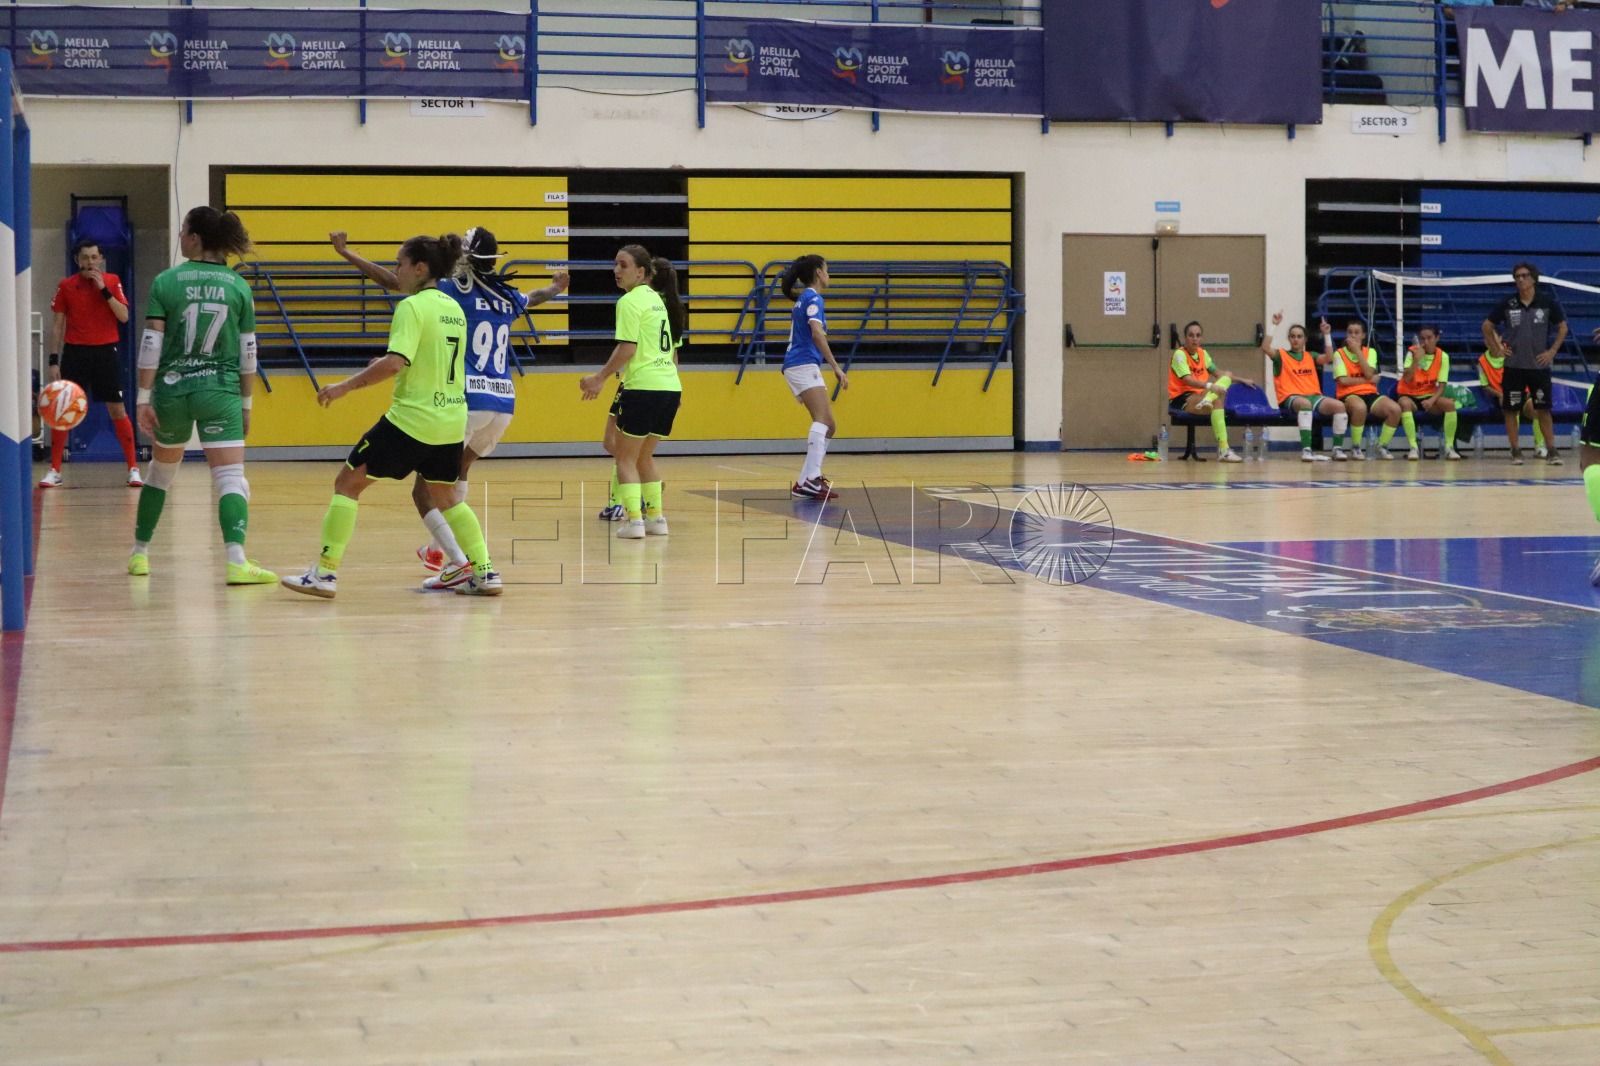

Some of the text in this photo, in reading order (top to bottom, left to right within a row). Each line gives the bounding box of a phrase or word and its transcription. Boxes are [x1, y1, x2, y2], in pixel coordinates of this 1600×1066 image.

[64, 38, 109, 48] MELILLA
[183, 40, 228, 49] MELILLA
[301, 40, 346, 50] MELILLA
[417, 40, 461, 50] MELILLA
[64, 49, 101, 58] SPORT
[183, 50, 220, 60] SPORT
[301, 51, 336, 60] SPORT
[417, 51, 452, 60] SPORT
[759, 46, 800, 58] MELILLA
[64, 58, 109, 69] CAPITAL
[183, 60, 228, 70] CAPITAL
[301, 60, 346, 70] CAPITAL
[417, 60, 461, 70] CAPITAL
[759, 56, 792, 67] SPORT
[867, 56, 908, 66] MELILLA
[974, 59, 1015, 68] MELILLA
[759, 66, 800, 78] CAPITAL
[867, 65, 901, 75] SPORT
[974, 68, 1008, 78] SPORT
[1464, 27, 1594, 110] ME
[867, 74, 908, 85] CAPITAL
[974, 78, 1015, 88] CAPITAL
[420, 98, 475, 108] SECTOR 1
[1361, 117, 1407, 126] SECTOR 3
[185, 286, 225, 300] SILVIA
[181, 302, 229, 356] 17
[659, 319, 671, 353] 6
[472, 320, 509, 375] 98
[446, 336, 460, 385] 7
[469, 378, 486, 391] MSC
